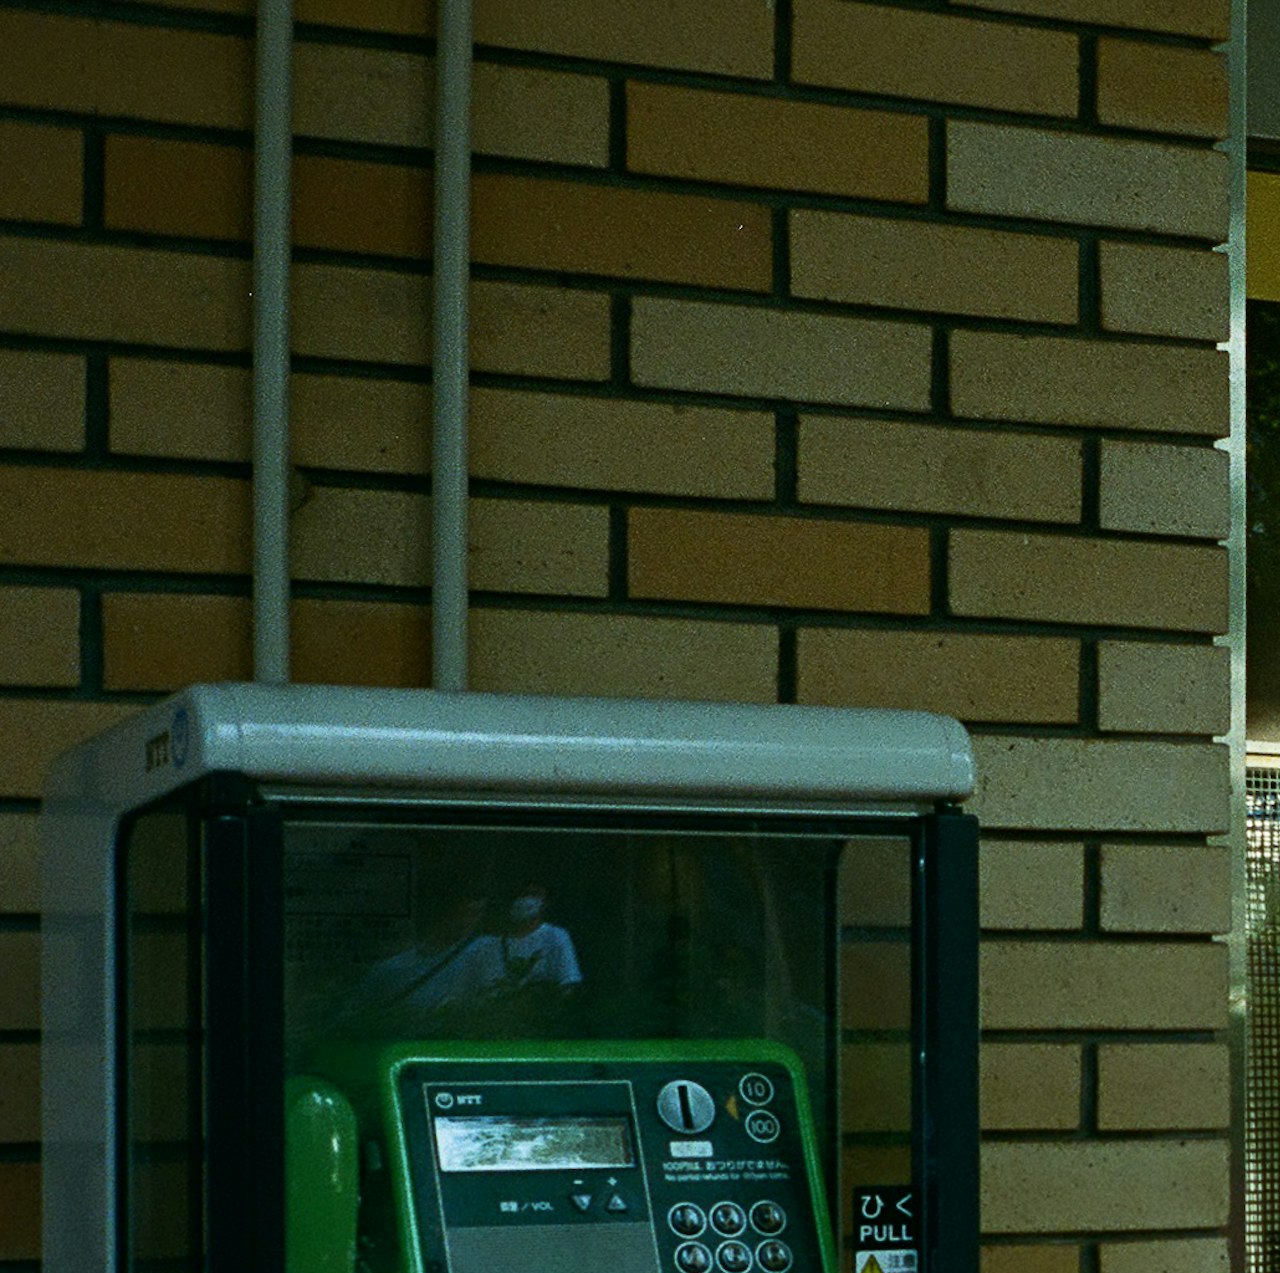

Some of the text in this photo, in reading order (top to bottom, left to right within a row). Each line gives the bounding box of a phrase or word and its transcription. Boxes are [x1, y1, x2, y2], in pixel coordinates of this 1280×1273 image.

[746, 1082, 766, 1098] 10
[457, 1094, 483, 1106] NTT
[751, 1119, 775, 1134] 100
[859, 1223, 914, 1242] PULL
